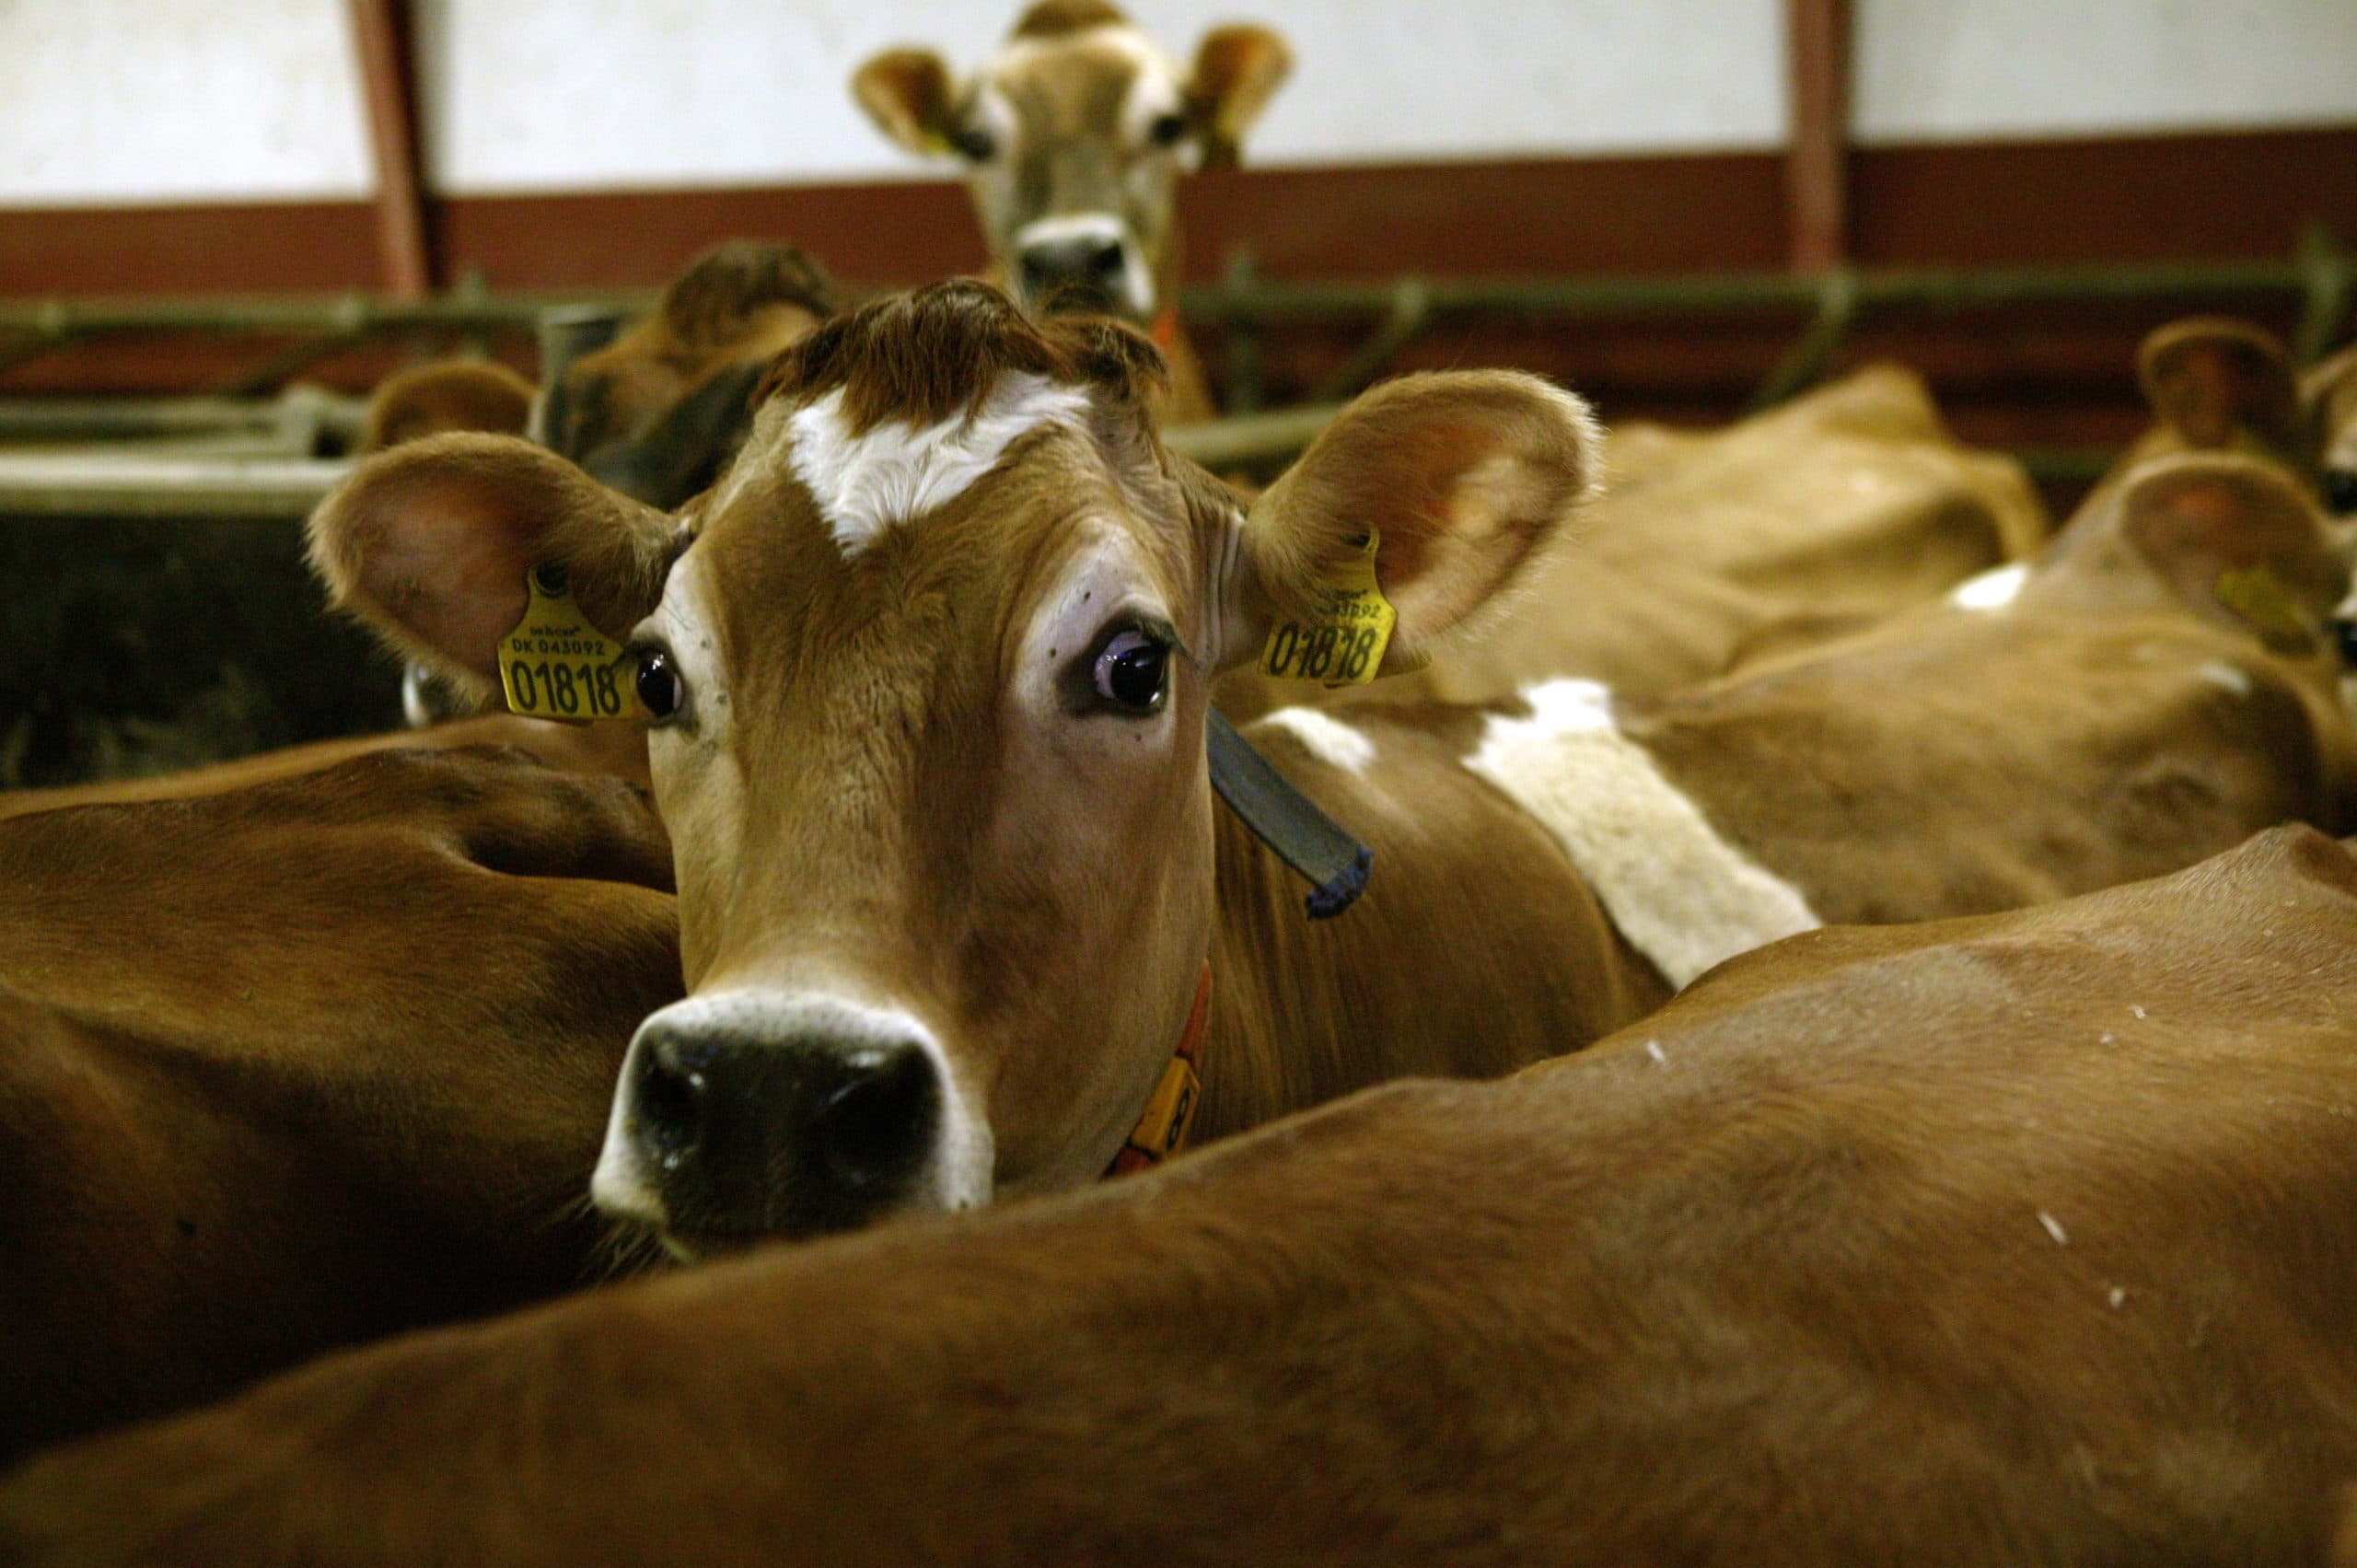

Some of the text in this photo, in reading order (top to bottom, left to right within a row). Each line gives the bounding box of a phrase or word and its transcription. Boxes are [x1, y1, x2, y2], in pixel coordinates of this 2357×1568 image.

[512, 638, 534, 653] DK
[1270, 622, 1376, 679] 01818
[511, 659, 621, 715] 01818
